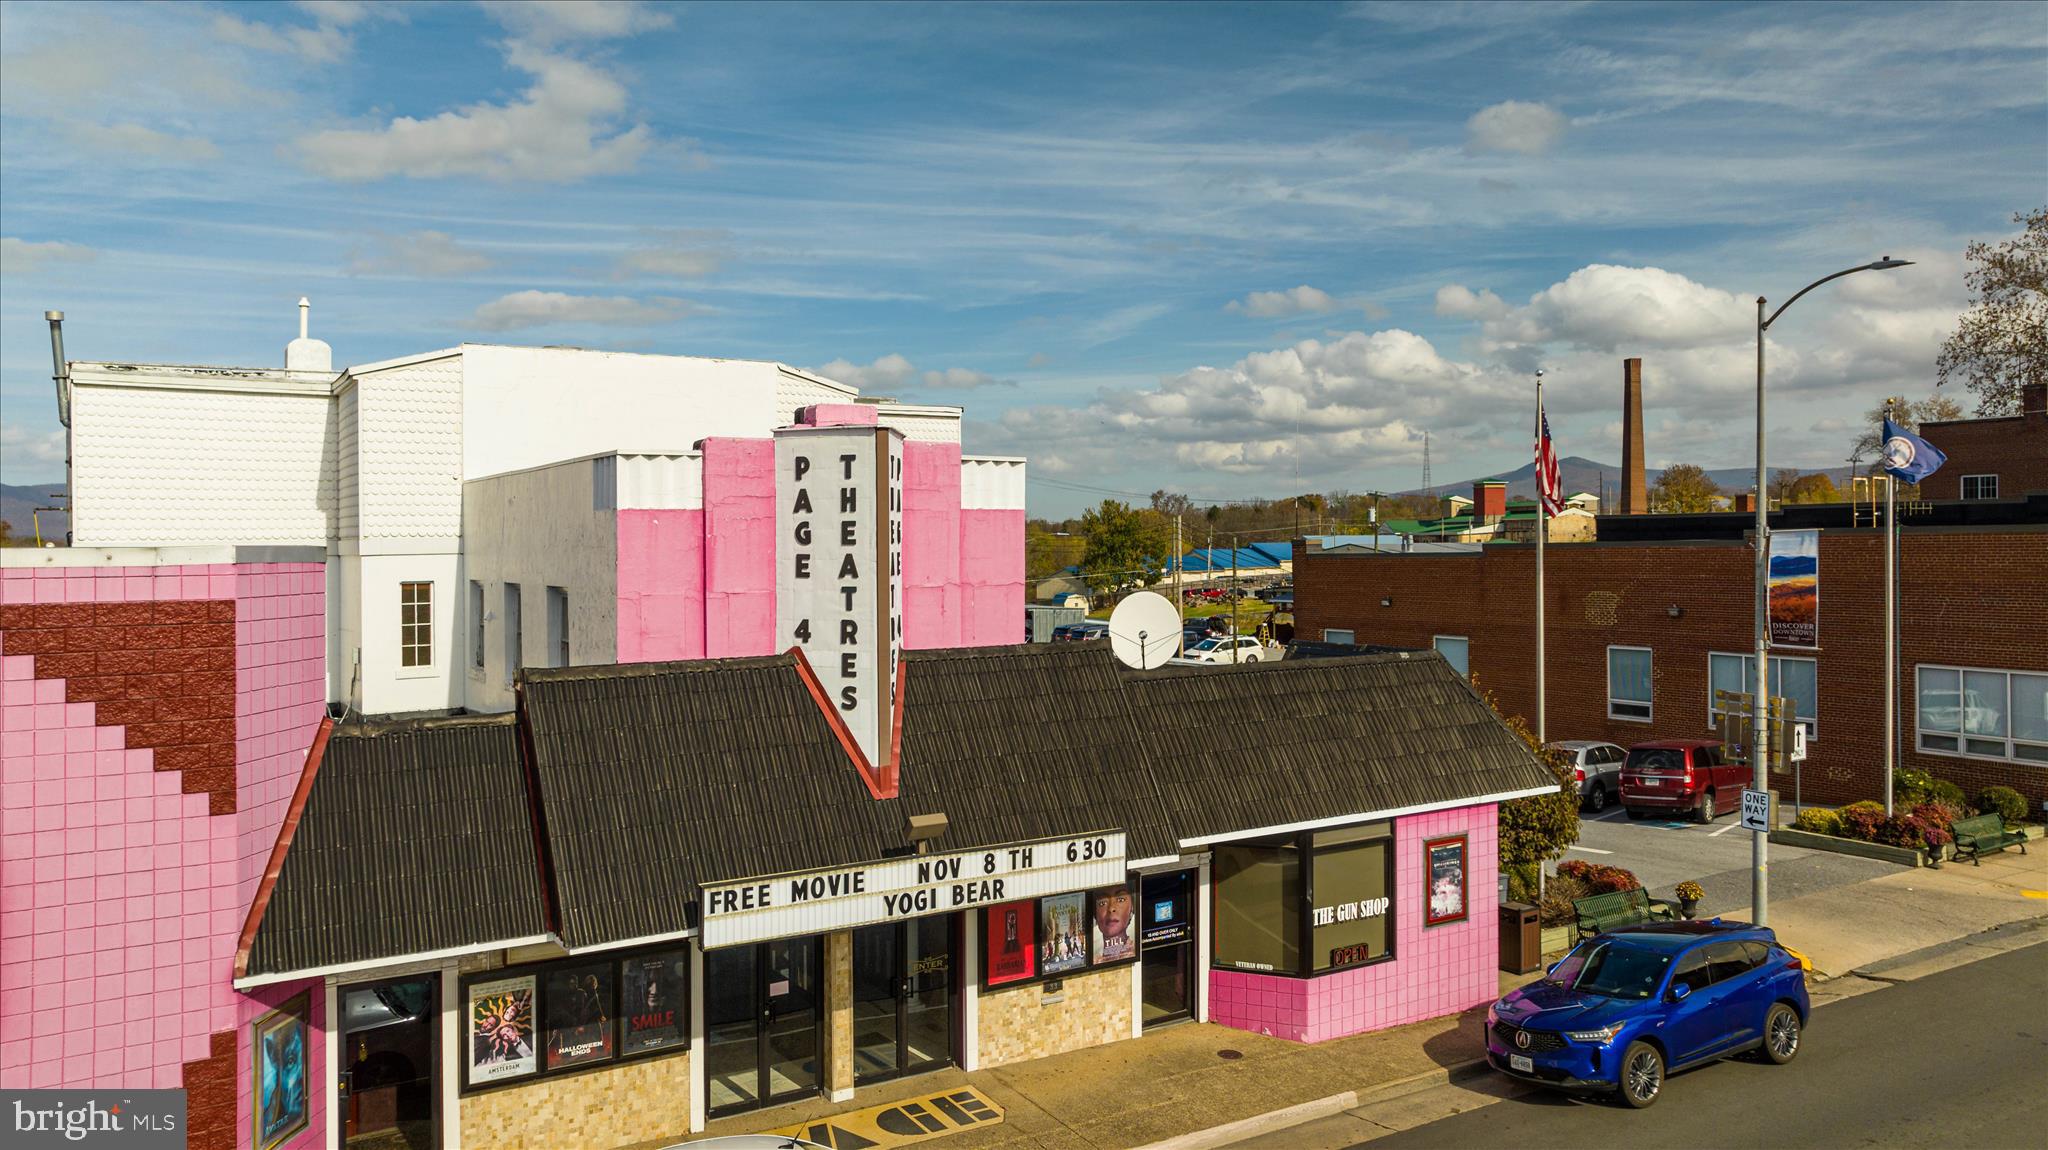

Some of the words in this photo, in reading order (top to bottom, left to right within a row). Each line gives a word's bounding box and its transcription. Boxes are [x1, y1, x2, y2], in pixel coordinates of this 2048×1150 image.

[793, 456, 812, 579] PAGE
[838, 454, 859, 711] THEATRES
[794, 619, 811, 644] 4
[1745, 793, 1766, 806] ONE
[1744, 803, 1767, 816] WAY
[709, 884, 771, 914] FREE
[791, 871, 865, 901] MOVIE
[918, 857, 962, 884] NOV
[983, 853, 996, 875] 8
[1008, 848, 1033, 870] TH
[883, 888, 937, 916] YOGI
[952, 879, 1005, 907] BEAR
[1313, 906, 1334, 926] THE
[1337, 902, 1358, 922] GUN
[1360, 897, 1389, 918] SHOP
[1105, 937, 1124, 947] TILL
[1335, 945, 1368, 966] OPEN
[912, 960, 943, 971] ENTER
[1235, 960, 1256, 969] VETERAN
[1256, 963, 1273, 971] OWNED
[631, 1010, 674, 1032] SMILE
[558, 1041, 603, 1055] HALLOWEEN
[571, 1048, 591, 1057] ENDS
[488, 1063, 520, 1075] AMSTERDAM
